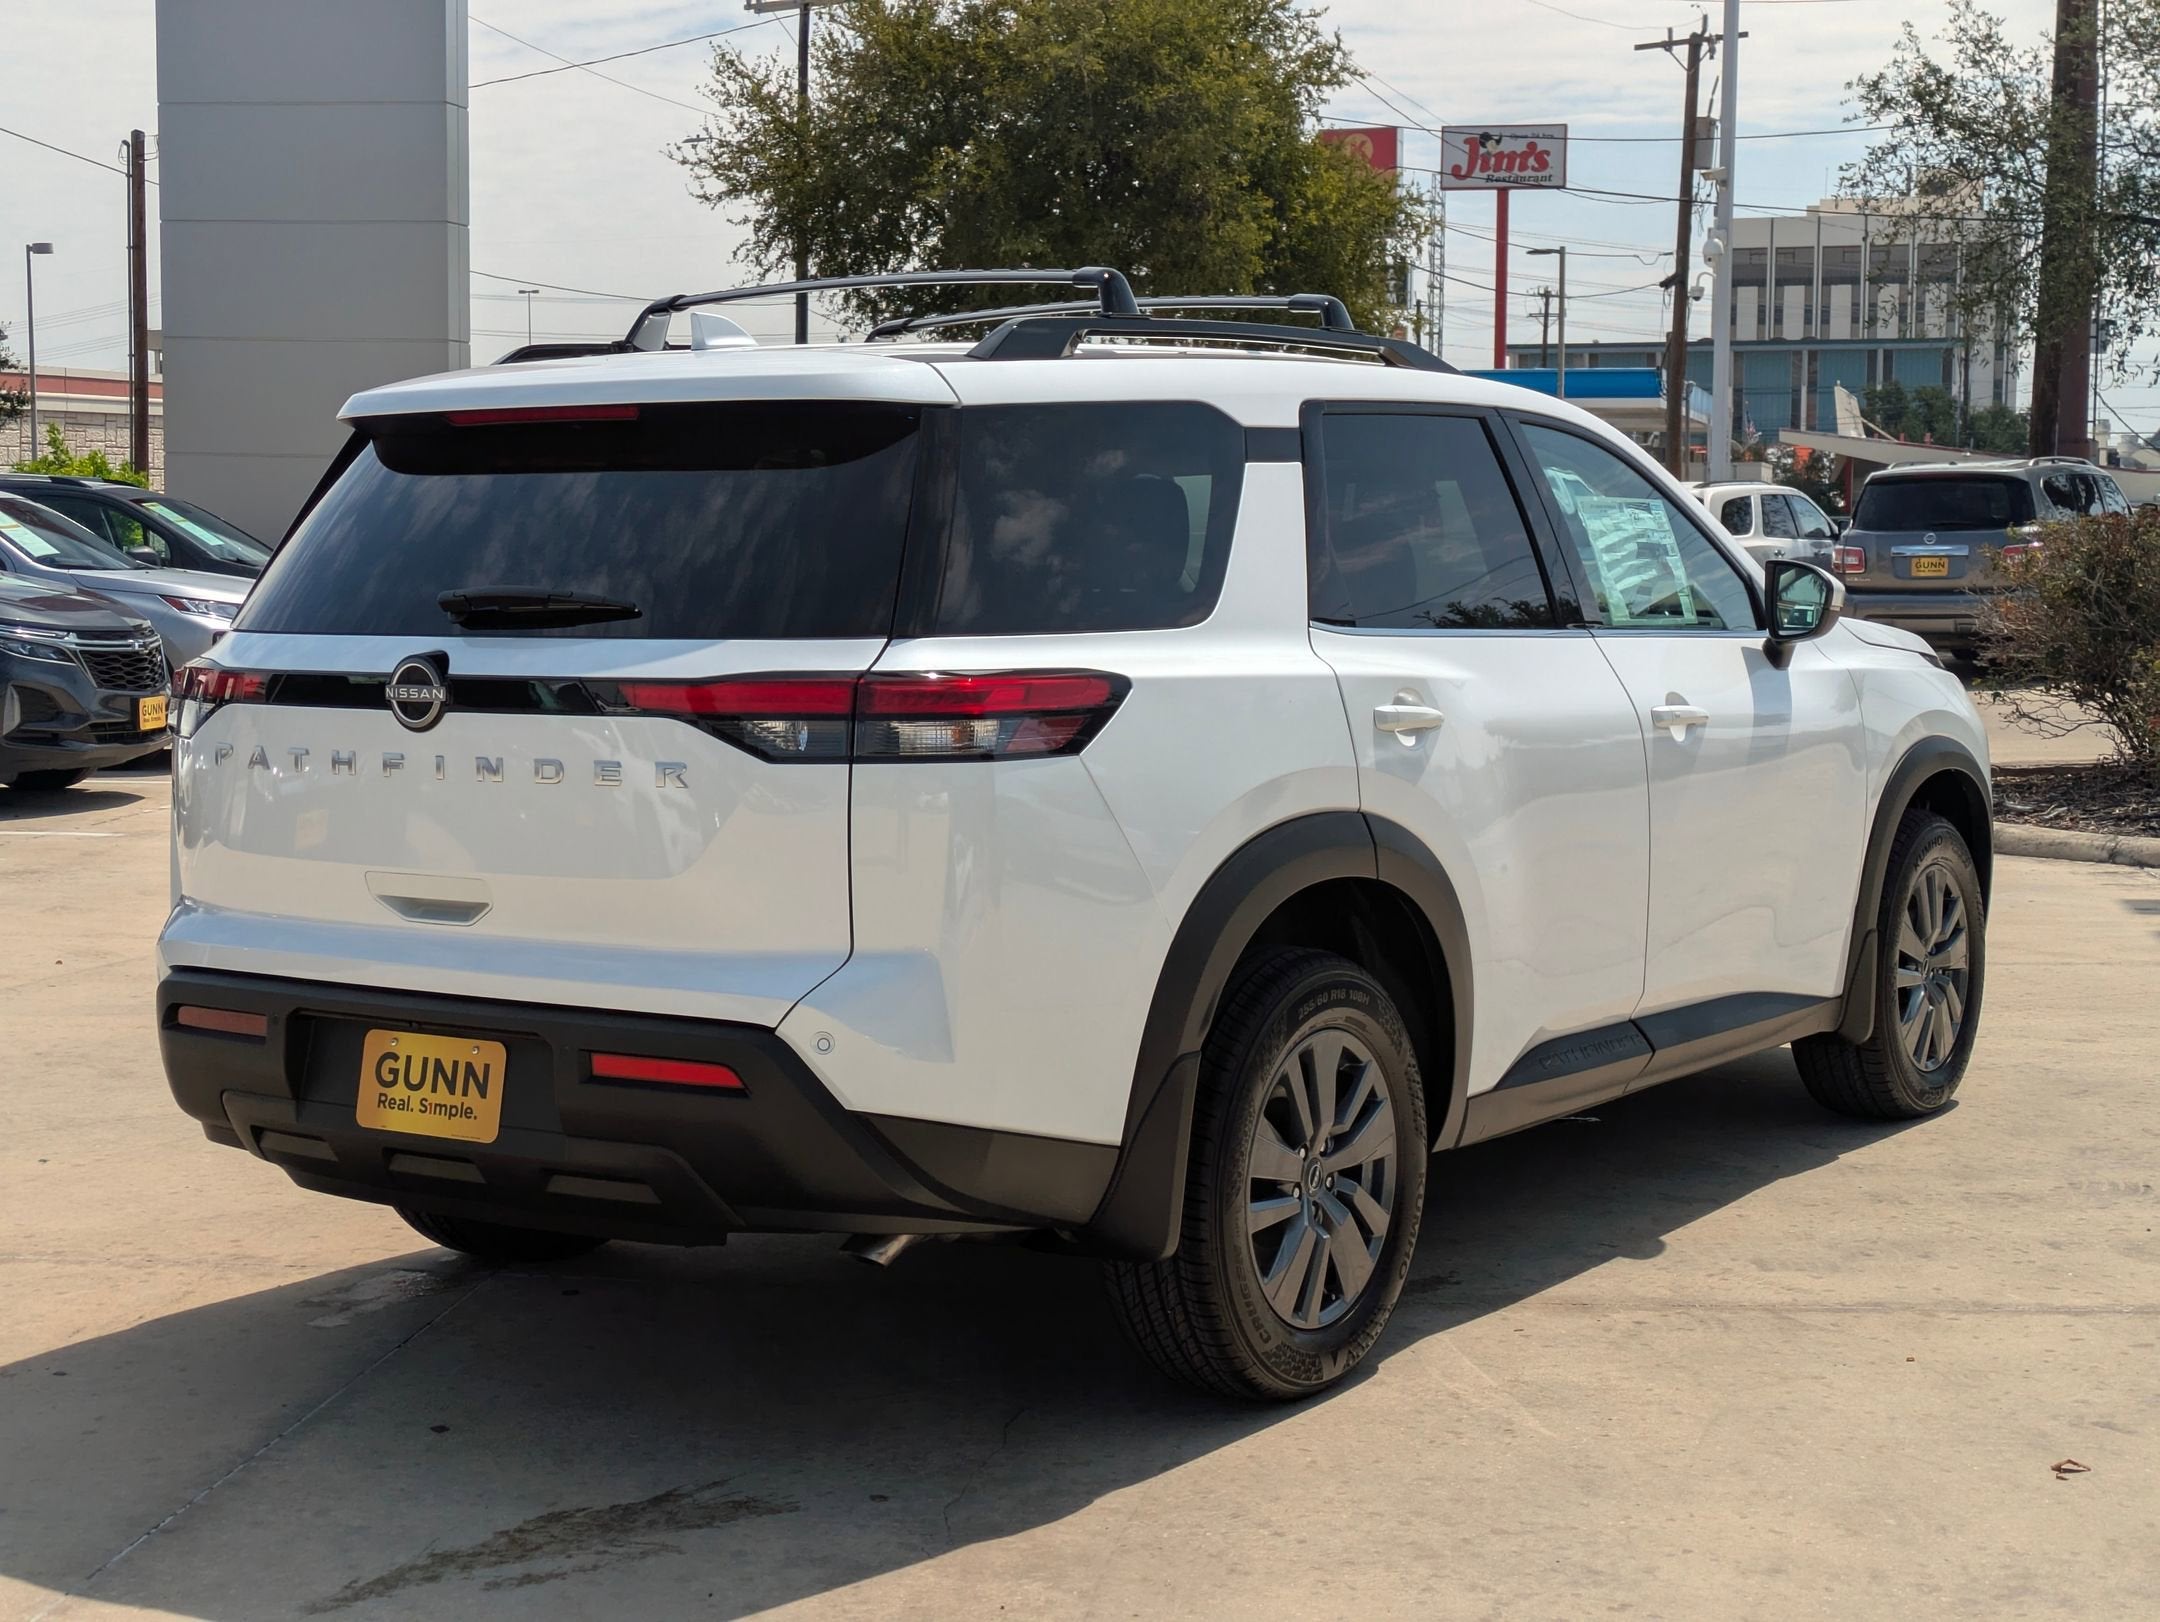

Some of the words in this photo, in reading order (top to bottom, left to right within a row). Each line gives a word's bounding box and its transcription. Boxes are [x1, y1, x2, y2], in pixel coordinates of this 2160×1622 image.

[1451, 136, 1551, 181] Jim's
[1485, 173, 1553, 184] Restaurant
[1915, 561, 1945, 569] GUNN
[385, 687, 444, 699] NISSAN
[142, 703, 164, 717] GUNN
[213, 741, 690, 789] PATHFINDER
[1913, 835, 1943, 871] KUMHO
[375, 1052, 490, 1099] GUNN
[377, 1092, 414, 1113] Real.
[1398, 1171, 1425, 1281] KUMHO
